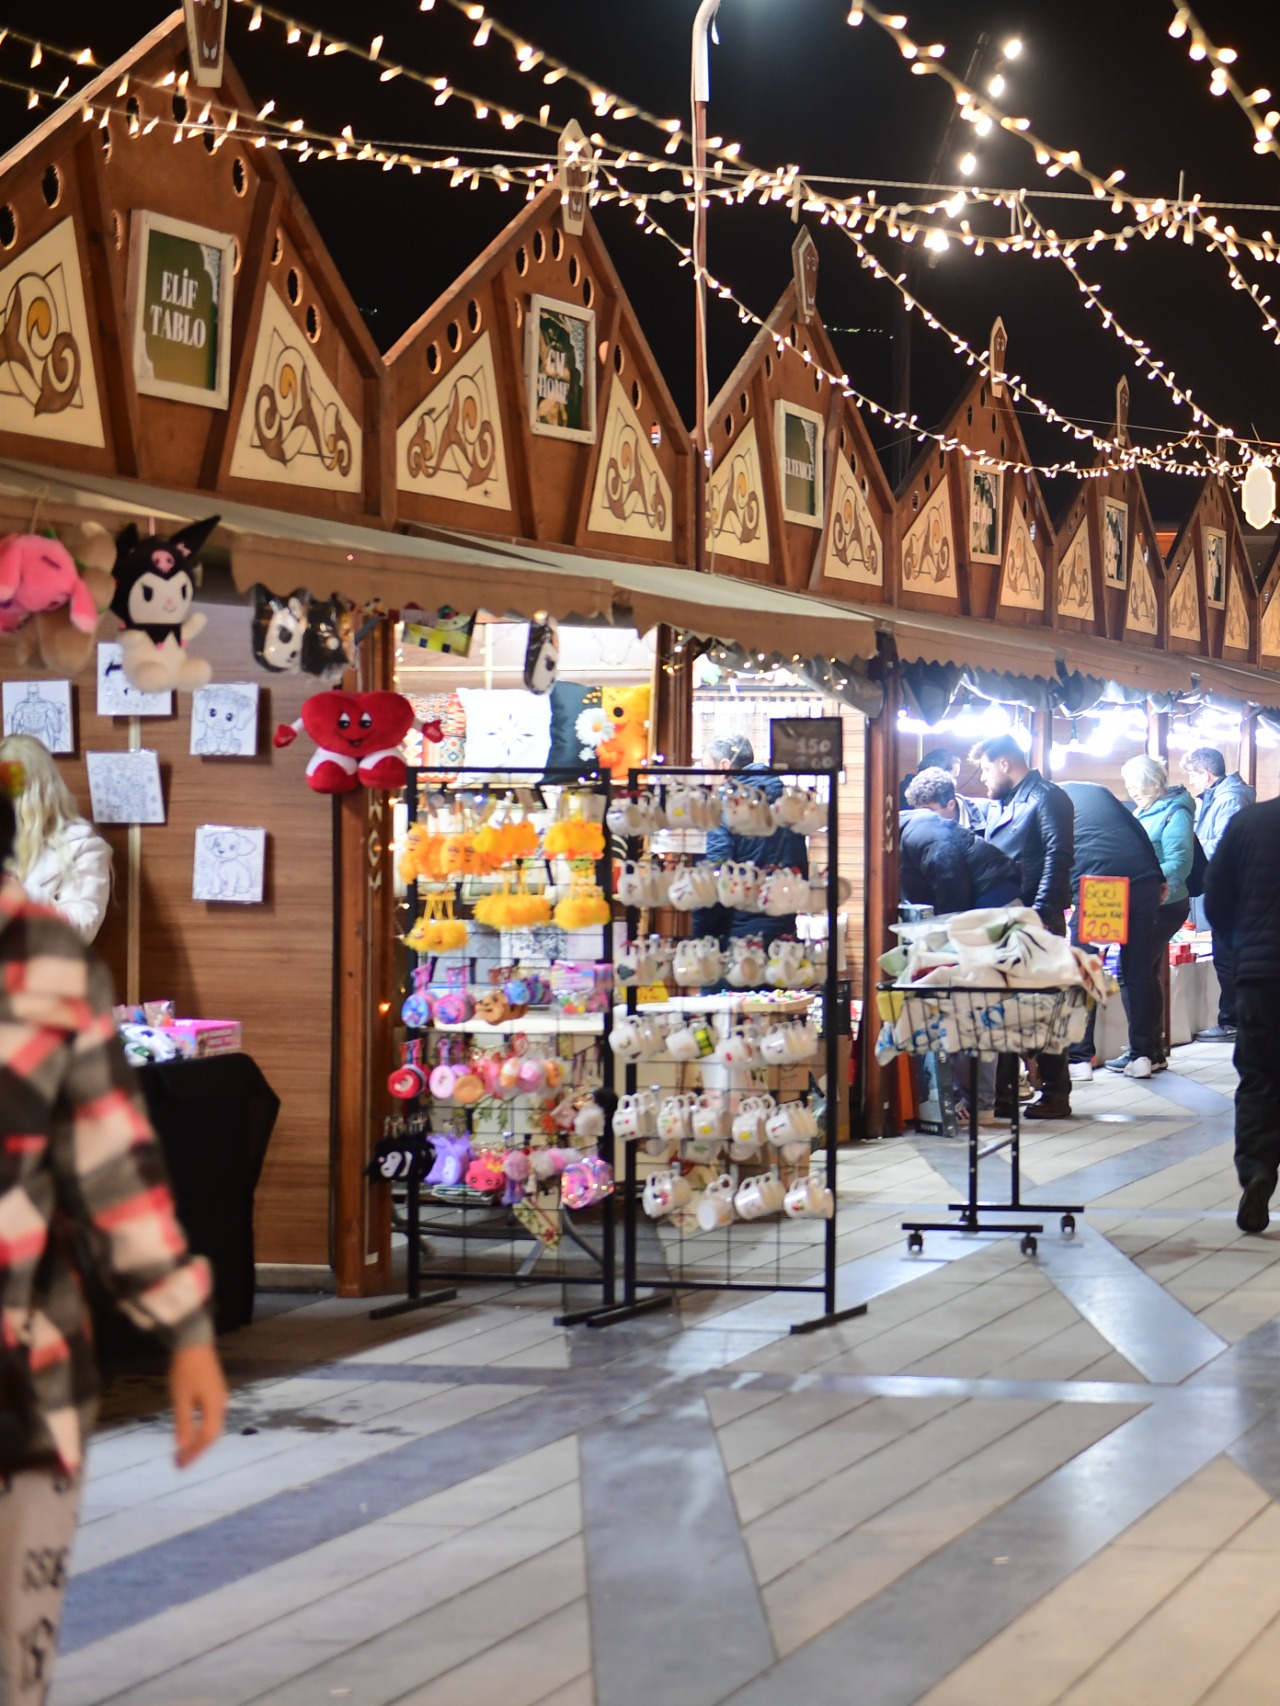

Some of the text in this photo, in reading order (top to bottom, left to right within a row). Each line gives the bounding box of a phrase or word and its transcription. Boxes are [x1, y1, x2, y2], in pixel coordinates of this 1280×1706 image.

[160, 267, 199, 310] ELİF
[150, 304, 207, 349] TABLO
[537, 372, 571, 405] HOME
